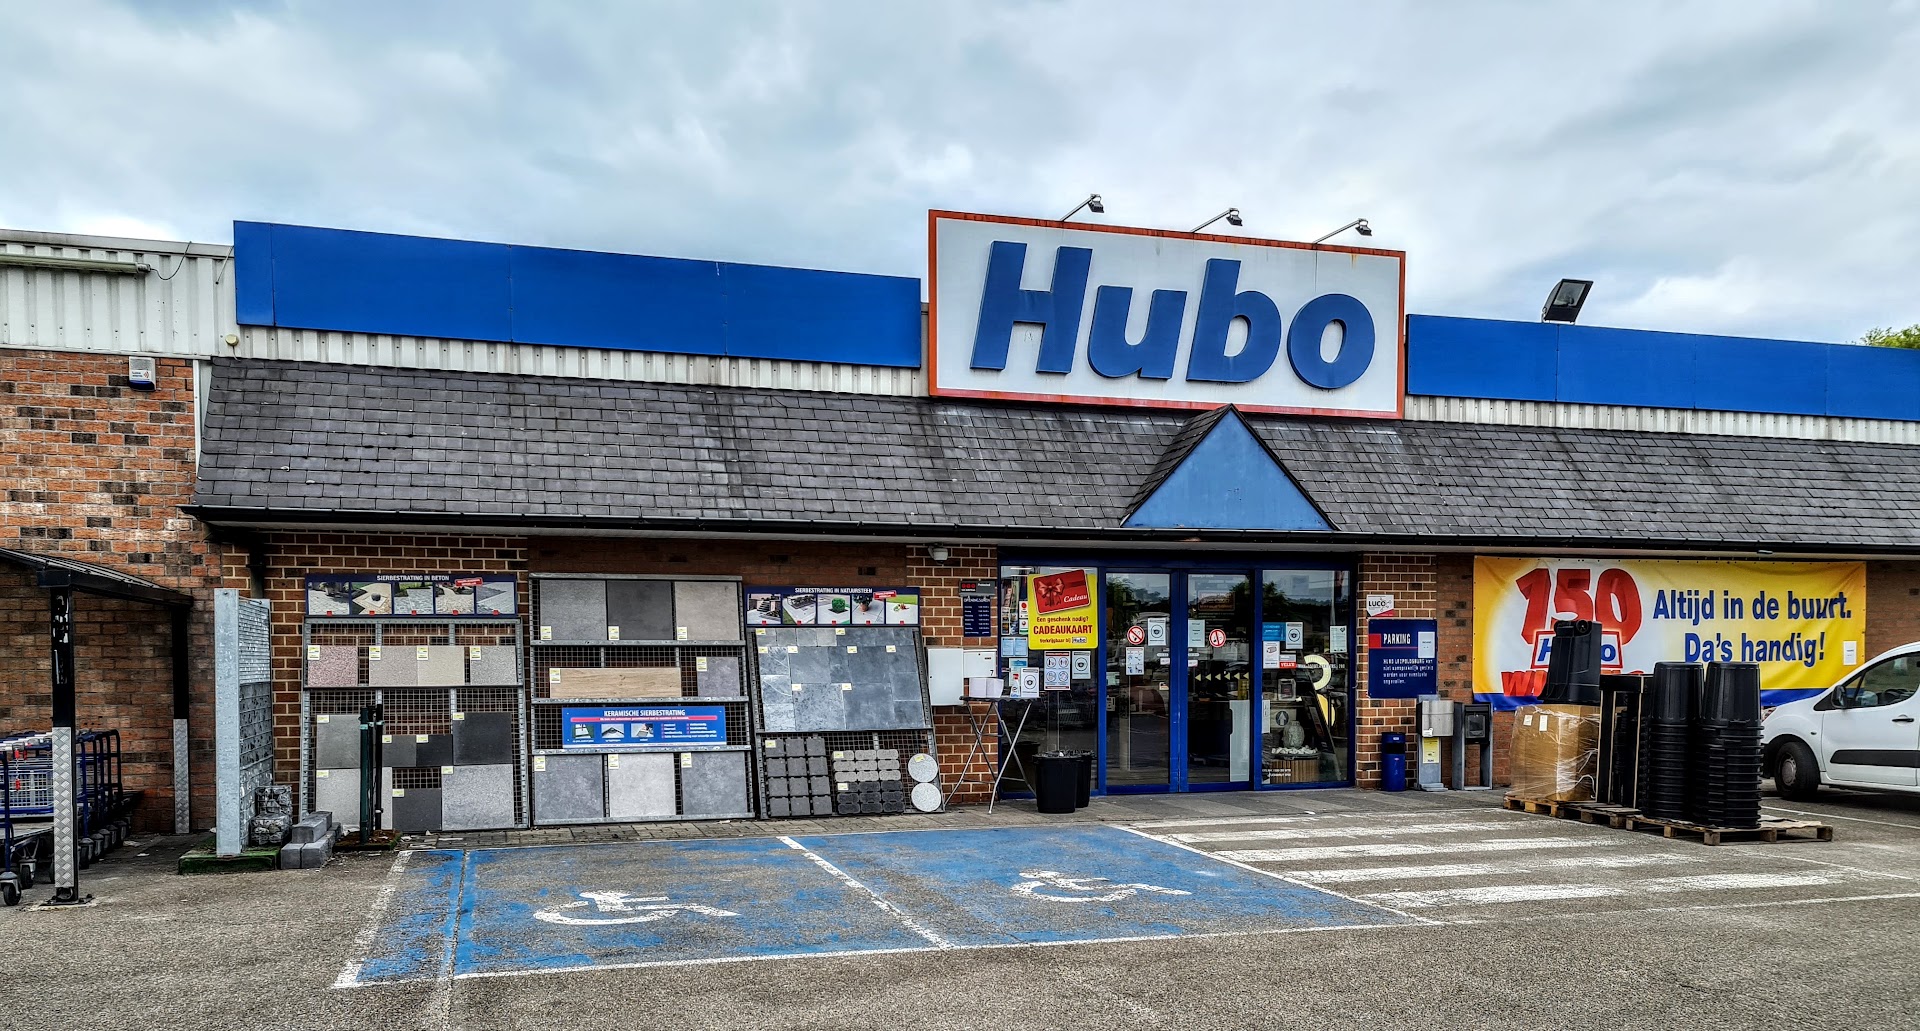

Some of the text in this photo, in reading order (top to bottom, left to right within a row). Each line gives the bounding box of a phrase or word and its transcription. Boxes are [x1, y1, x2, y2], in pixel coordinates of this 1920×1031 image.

[970, 241, 1376, 389] Hubo
[1063, 594, 1088, 603] Cadeau
[1515, 567, 1643, 645] 150
[1653, 589, 1852, 626] Altijd in de buurt.
[1033, 625, 1093, 635] CADEAUKAART
[1383, 633, 1411, 645] PARKING
[1741, 631, 1826, 667] handig!
